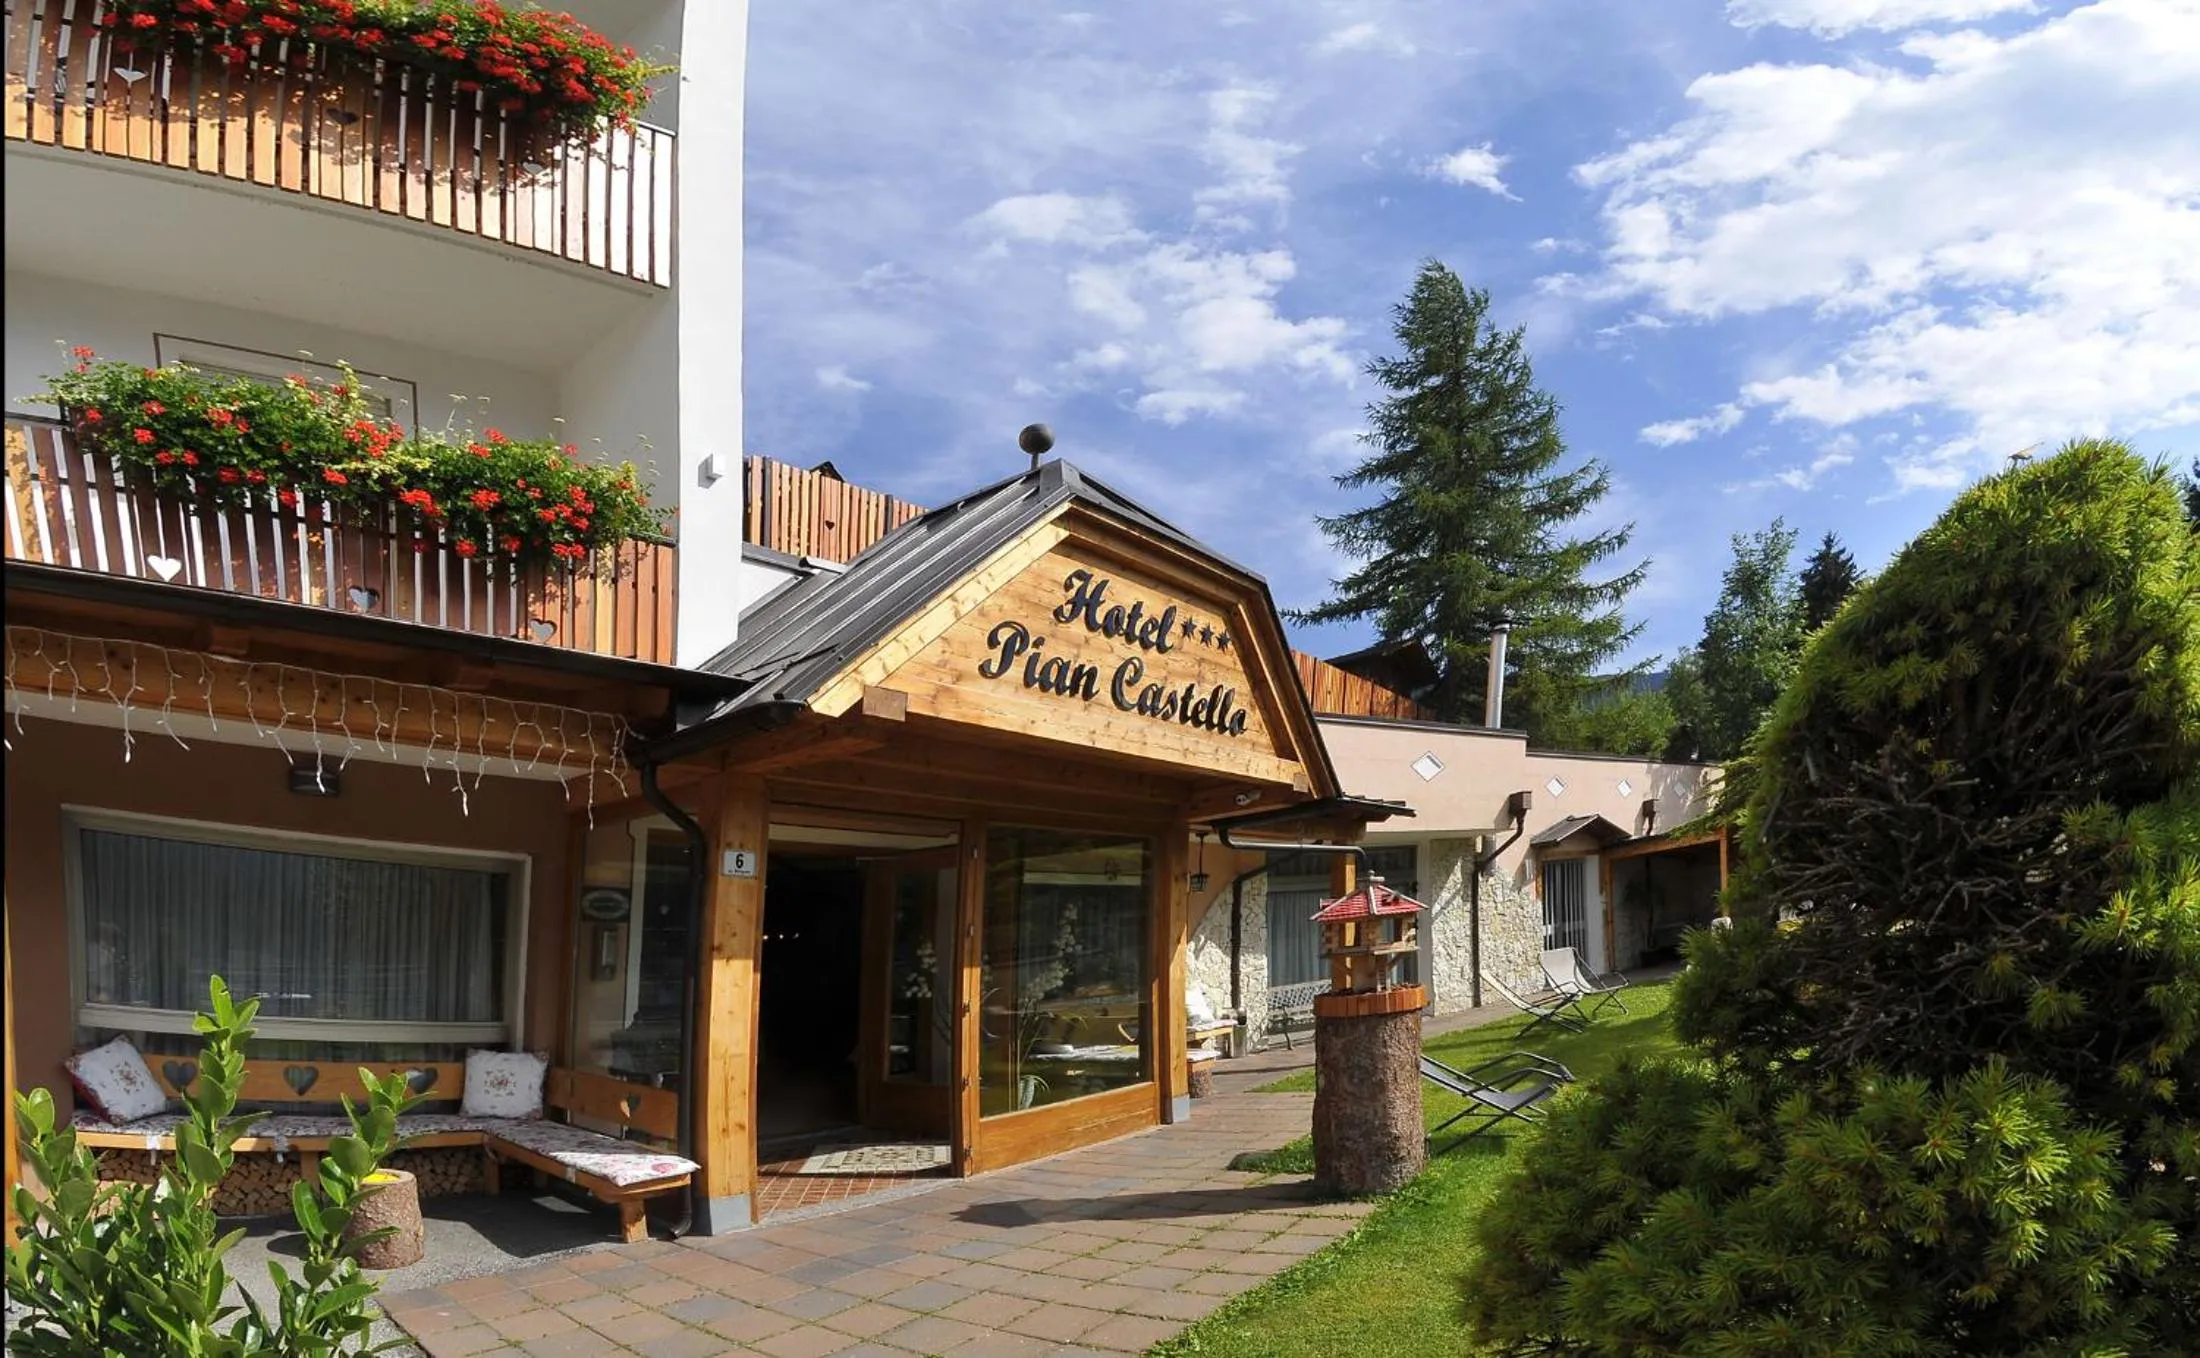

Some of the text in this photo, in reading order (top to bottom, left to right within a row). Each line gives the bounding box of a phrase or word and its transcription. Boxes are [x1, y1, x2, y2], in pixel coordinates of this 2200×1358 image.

[1053, 569, 1176, 653] Hotel
[978, 620, 1247, 737] Pian Castello
[735, 853, 744, 869] 6
